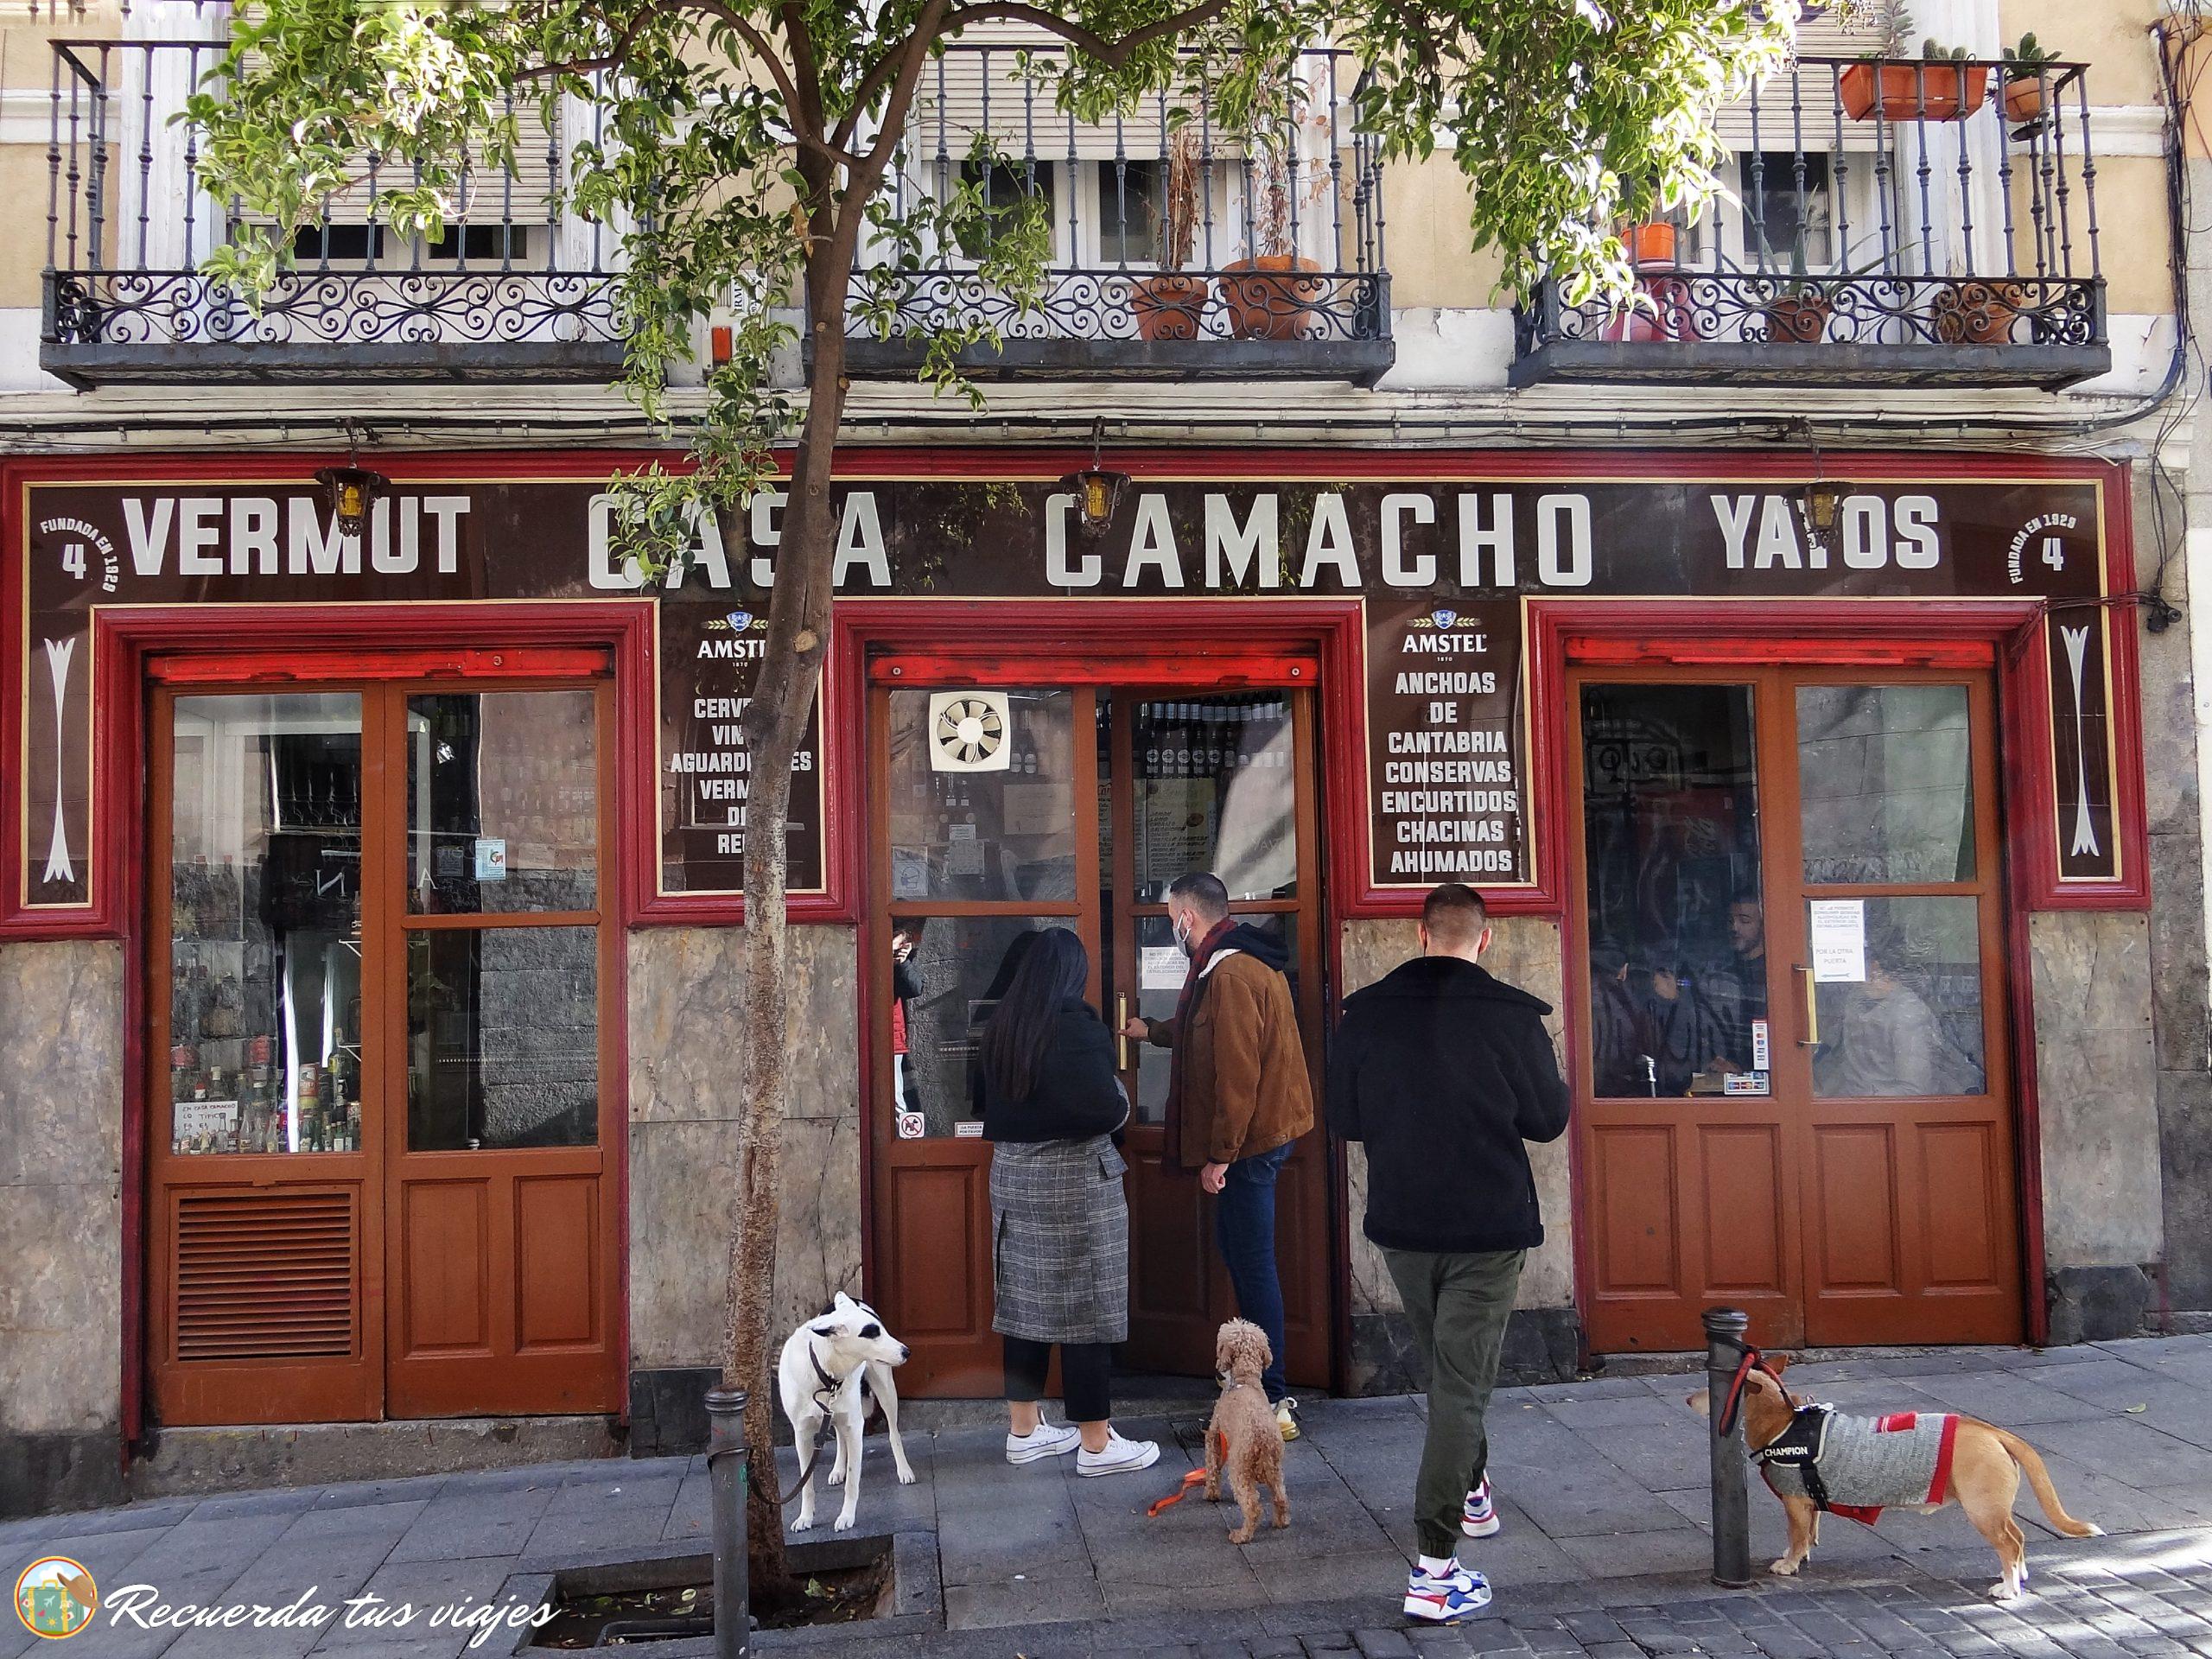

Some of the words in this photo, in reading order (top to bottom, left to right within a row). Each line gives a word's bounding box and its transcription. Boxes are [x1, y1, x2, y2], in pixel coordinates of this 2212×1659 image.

[40, 518, 99, 542] FUNDADA
[95, 536, 114, 555] EN
[122, 496, 471, 575] VERMUT
[1046, 493, 1592, 588] CAMACHO
[62, 543, 86, 580] 4
[2007, 530, 2030, 584] FUNDADA
[2024, 518, 2043, 534] EN
[2042, 537, 2064, 571] 4
[696, 639, 766, 658] AMST
[1402, 634, 1487, 653] AMSTEL
[1395, 672, 1496, 695] ANCHOAS
[1429, 702, 1458, 724] DE
[1388, 731, 1507, 753] CANTABRIA
[1385, 760, 1511, 784] CONSERVAS
[1382, 791, 1517, 813] ENCURTIDOS
[1396, 820, 1504, 843] CHACINAS
[1390, 849, 1512, 873] AHUMADOS
[1764, 1446, 1808, 1457] CHAMPION
